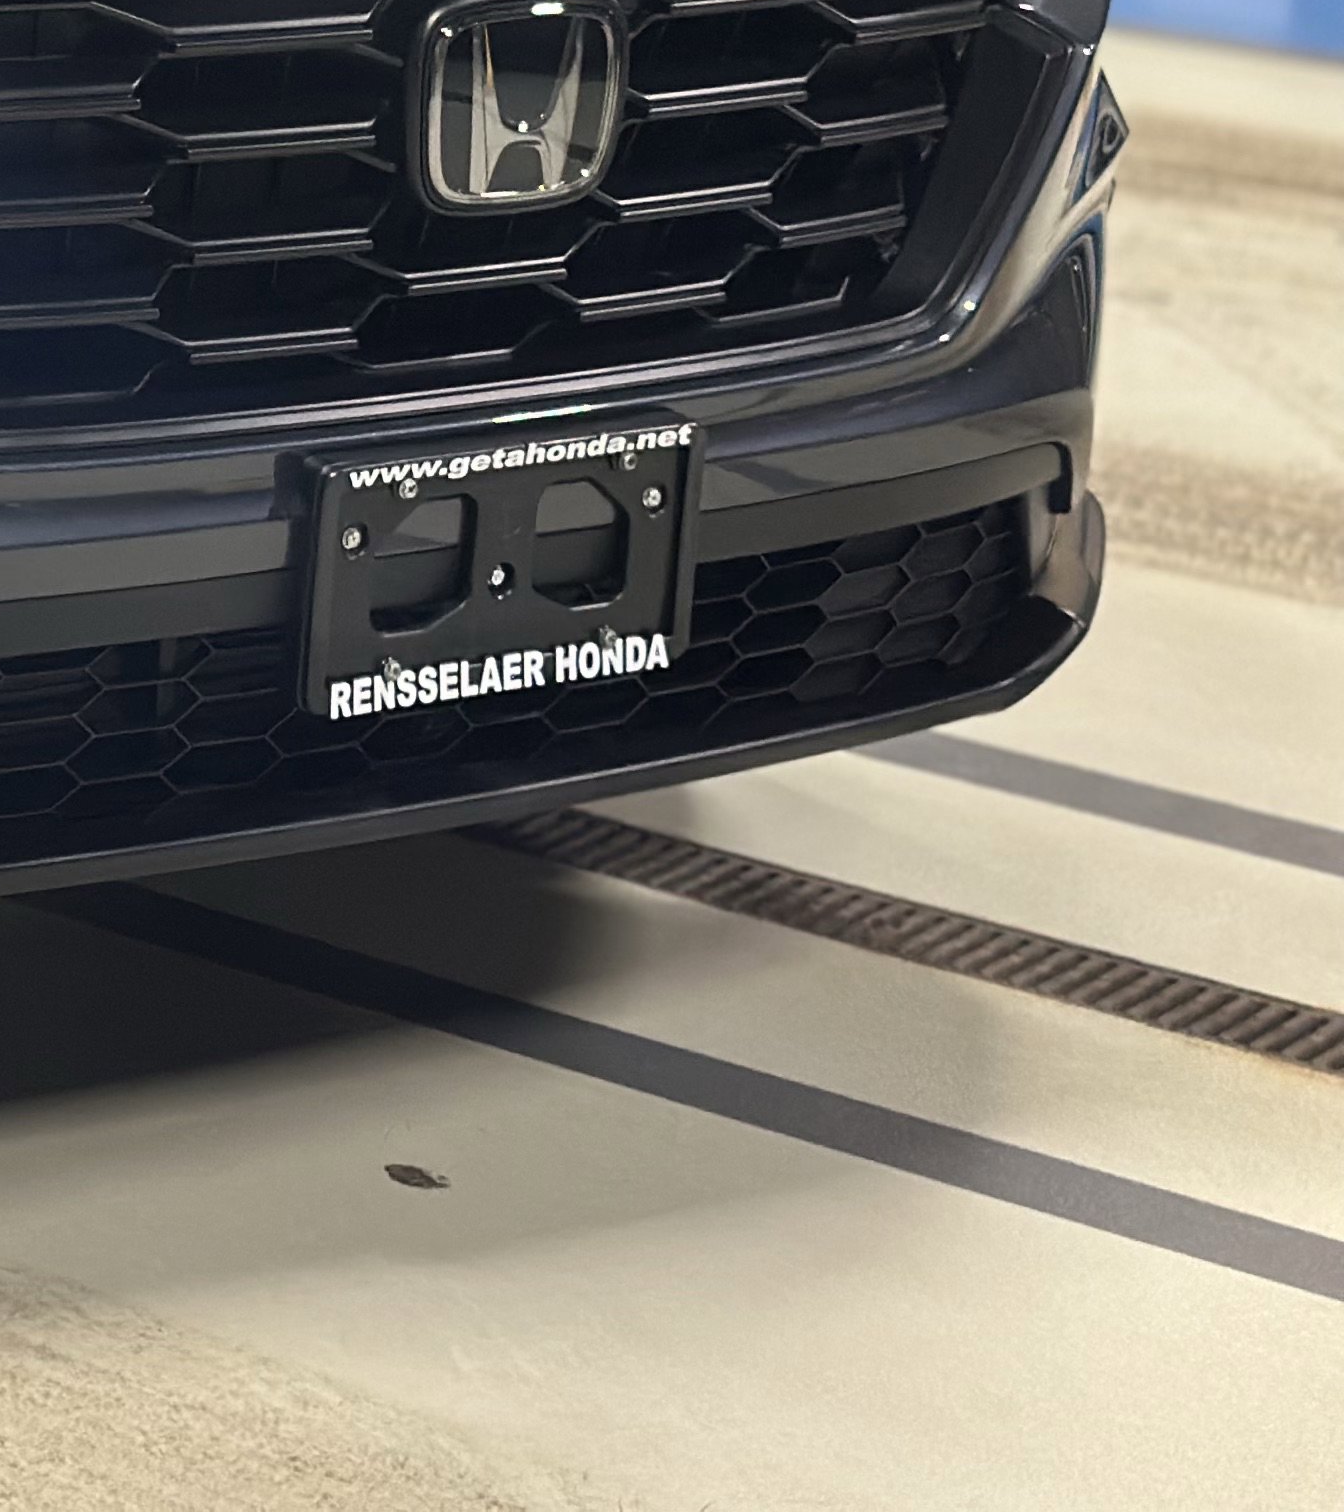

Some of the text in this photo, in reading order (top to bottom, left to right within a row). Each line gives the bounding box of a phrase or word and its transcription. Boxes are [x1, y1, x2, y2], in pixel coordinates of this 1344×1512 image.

[350, 425, 692, 488] www.getahonda.net
[329, 633, 669, 720] RENSSELAER HONDA
